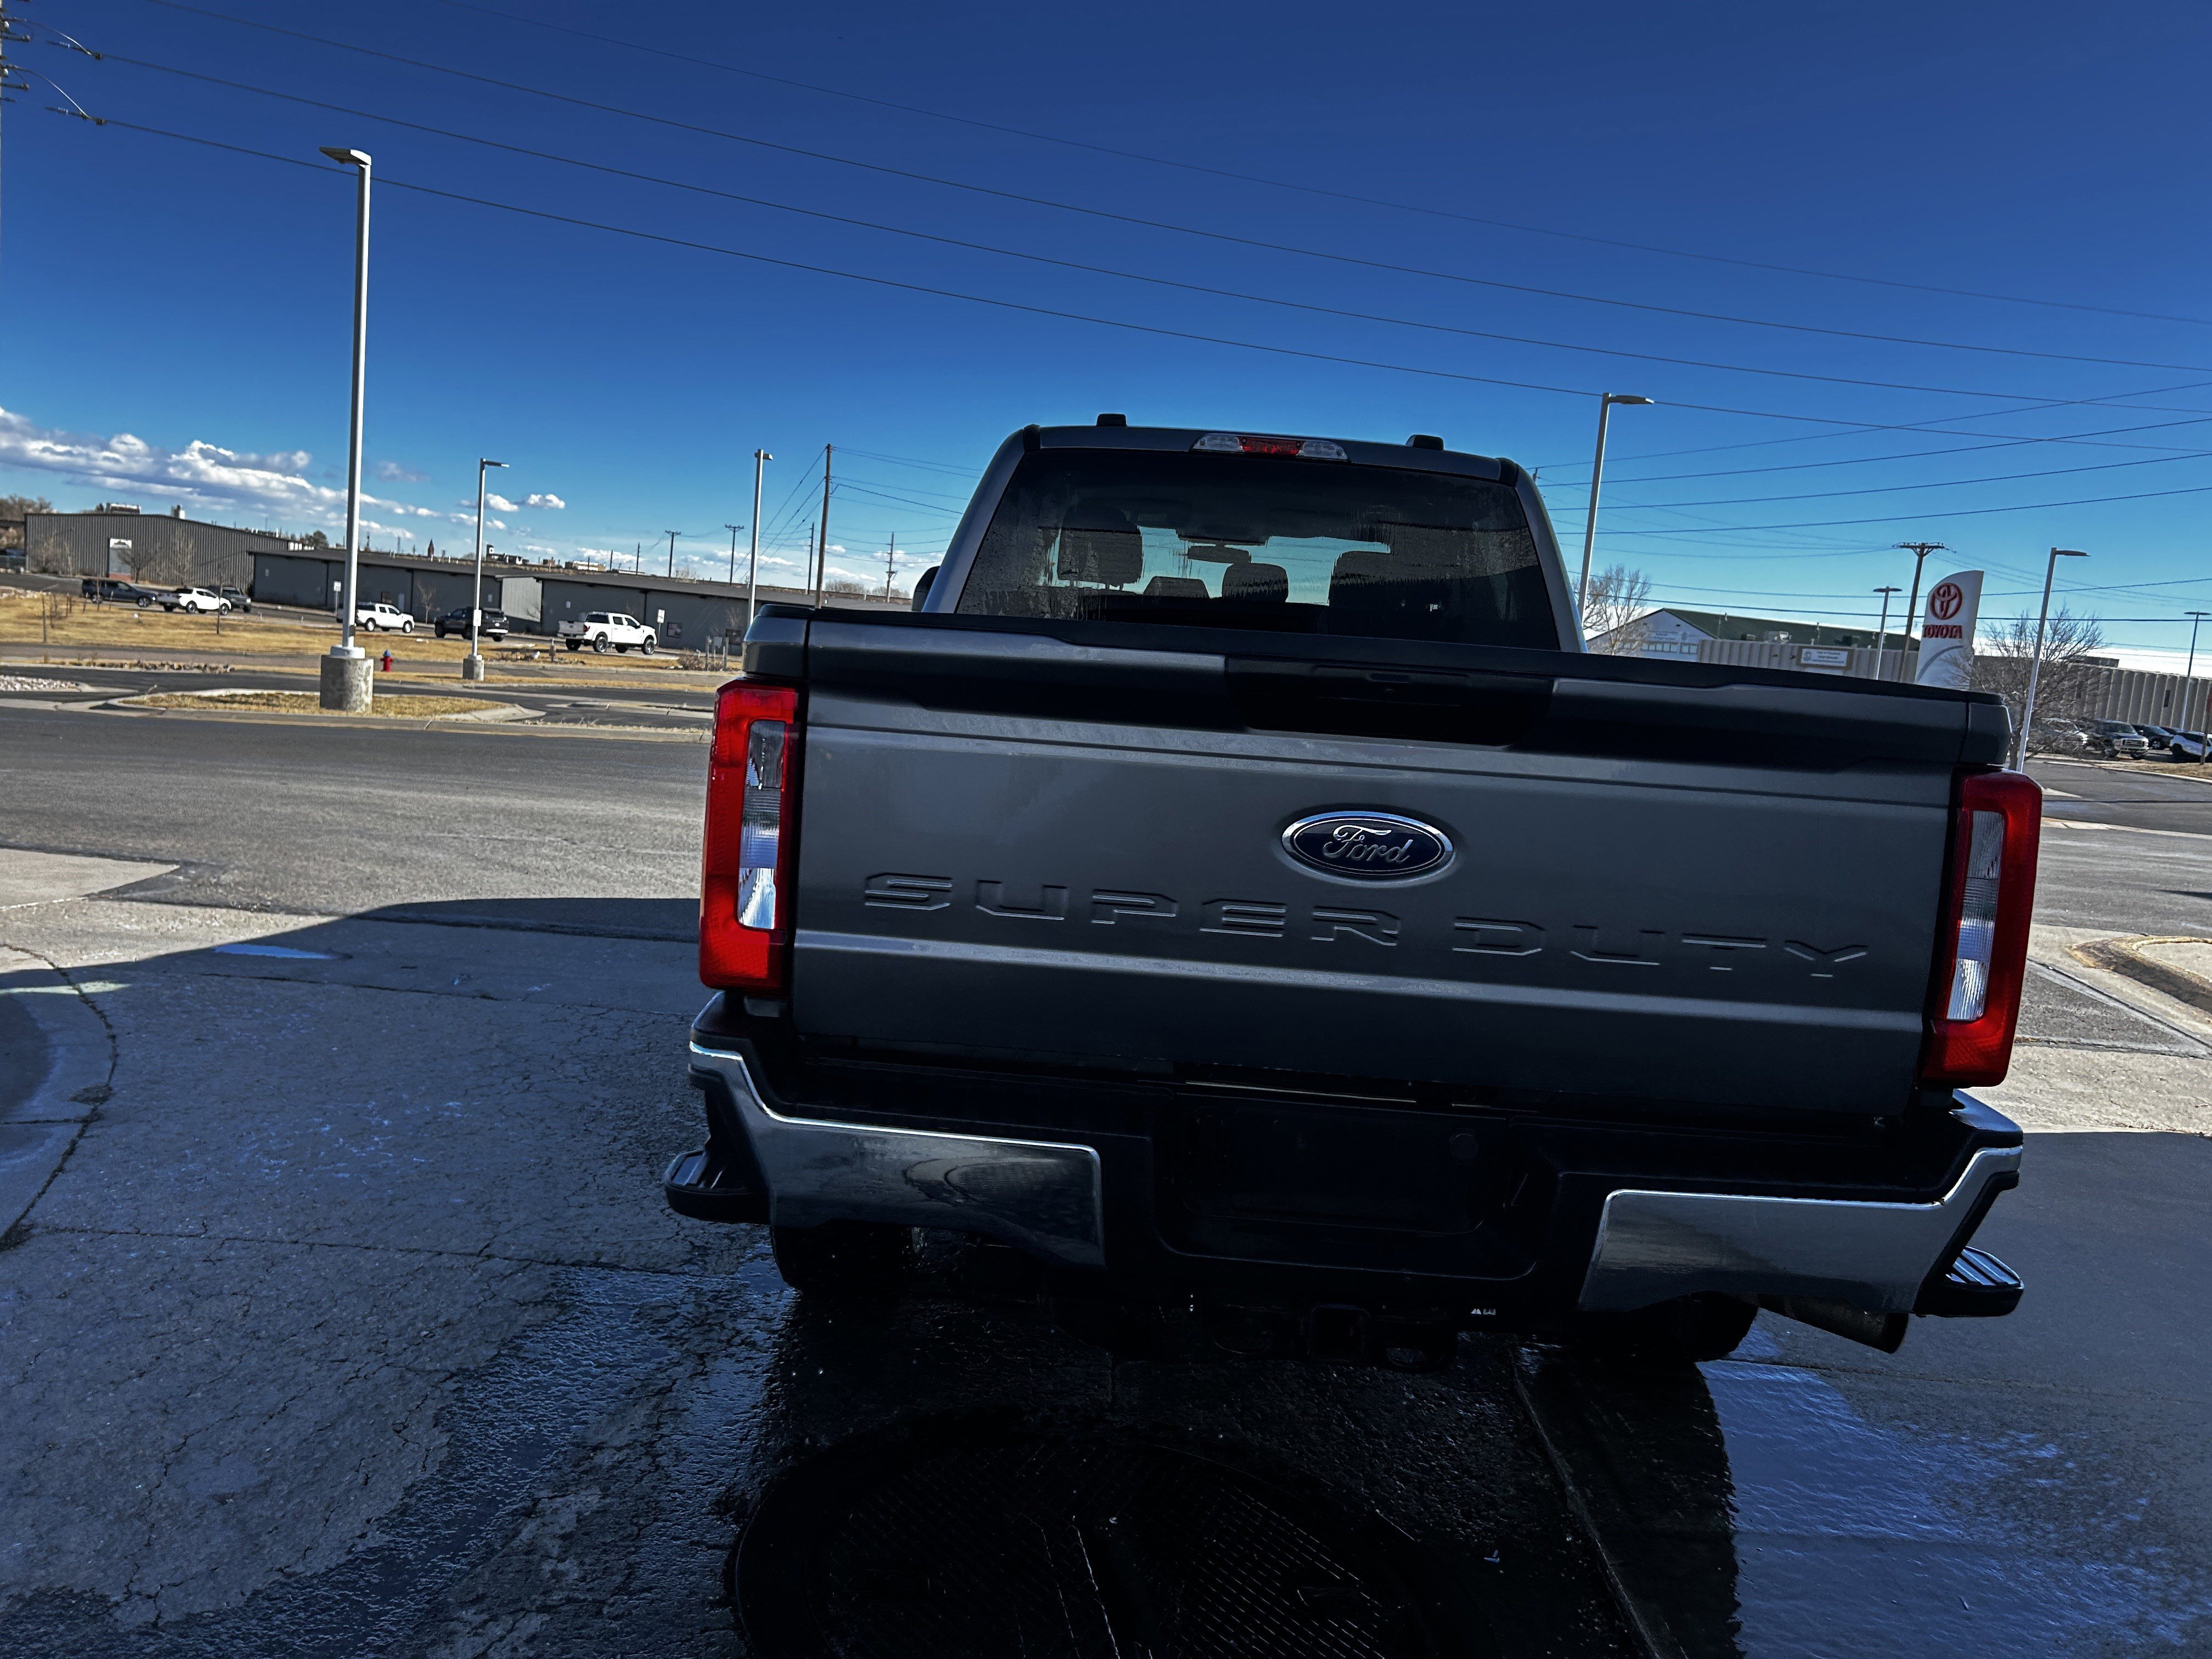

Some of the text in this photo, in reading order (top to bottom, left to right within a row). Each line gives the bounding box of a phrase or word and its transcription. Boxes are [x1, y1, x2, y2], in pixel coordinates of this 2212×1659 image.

[1922, 625, 1962, 638] TOYOTA
[1323, 824, 1414, 865] Ford
[865, 872, 1868, 978] SUPER DUTY
